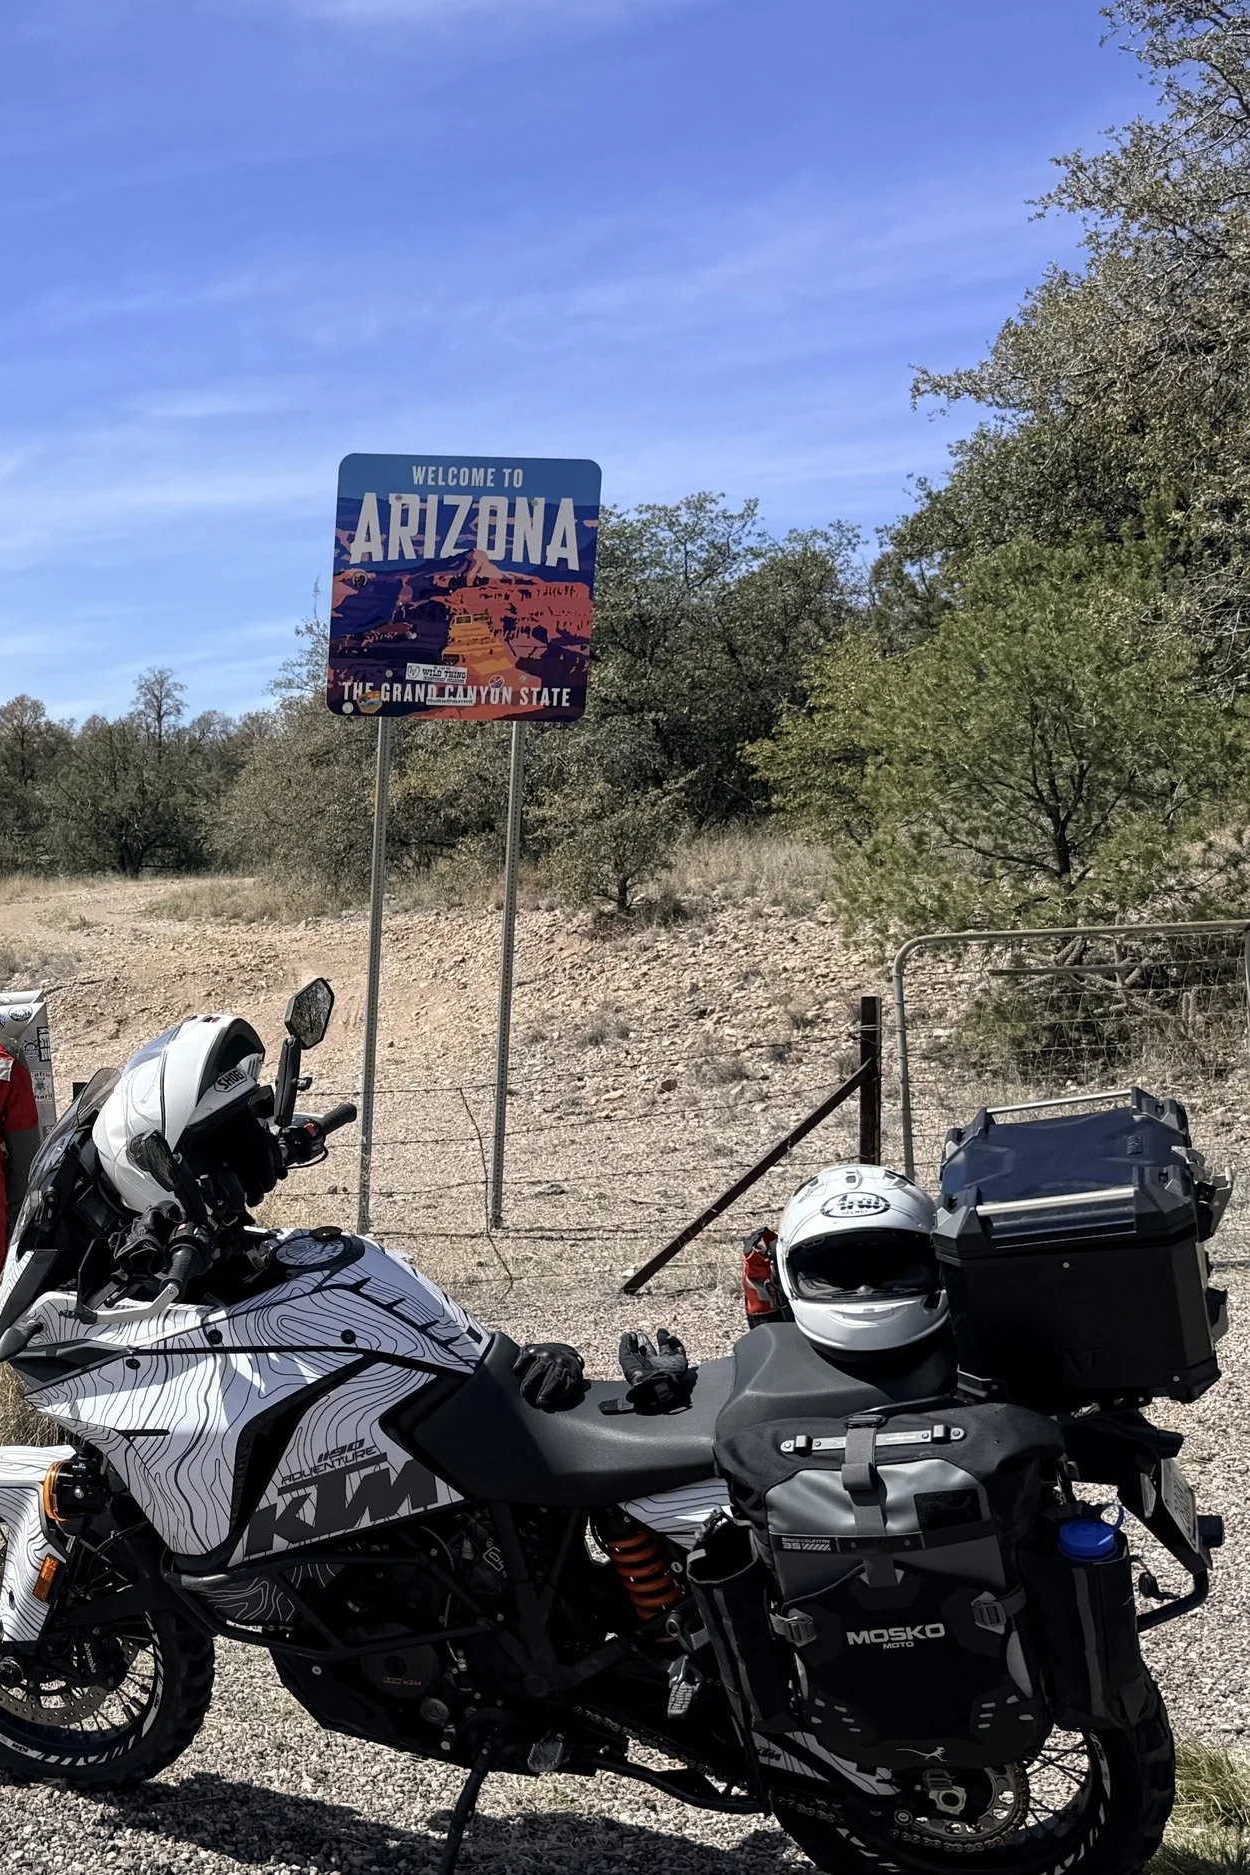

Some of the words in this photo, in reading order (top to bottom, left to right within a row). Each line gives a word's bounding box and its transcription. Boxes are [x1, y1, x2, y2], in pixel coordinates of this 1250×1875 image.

[412, 466, 496, 487] WELCOME
[502, 468, 524, 488] TO
[349, 492, 581, 572] ARIZONA
[342, 681, 374, 701] THE
[380, 683, 437, 703] GRAND
[444, 685, 512, 705] CANYON
[519, 687, 571, 707] STATE
[317, 1438, 366, 1463] 1190
[281, 1445, 377, 1485] ADVENTURE
[244, 1452, 439, 1557] KTM
[846, 1623, 946, 1645] MOSKO
[882, 1641, 915, 1650] MOTO
